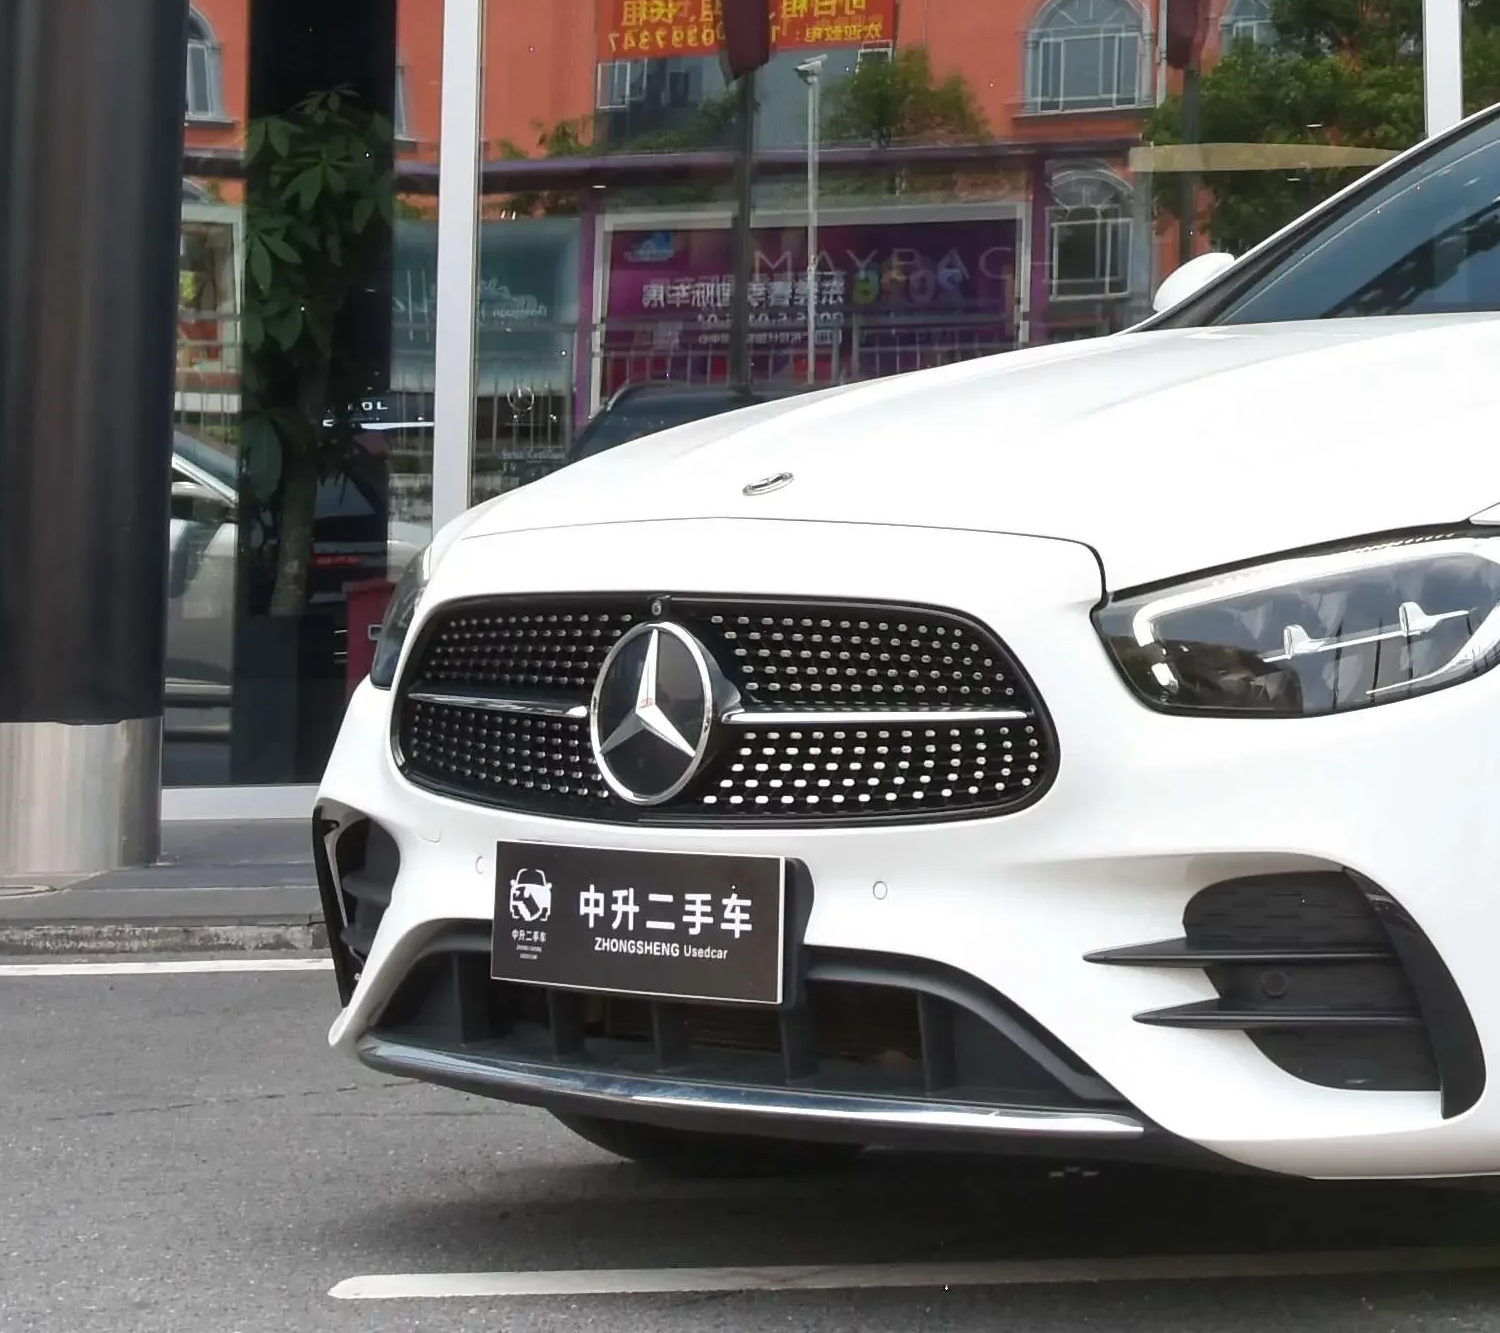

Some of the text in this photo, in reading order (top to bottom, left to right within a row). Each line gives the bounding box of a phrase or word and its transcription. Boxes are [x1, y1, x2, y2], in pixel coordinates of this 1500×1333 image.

[578, 884, 753, 939] 中升二手车
[594, 936, 728, 960] ZHONGSHENG Usedcar
